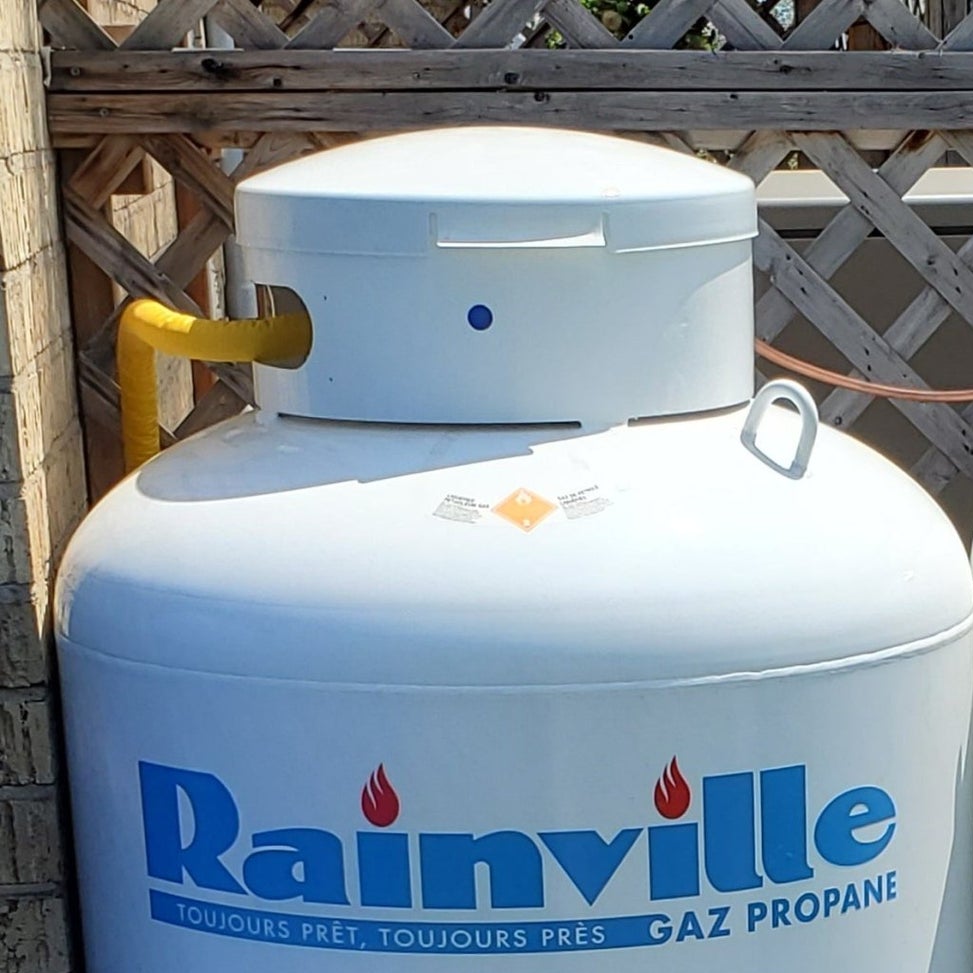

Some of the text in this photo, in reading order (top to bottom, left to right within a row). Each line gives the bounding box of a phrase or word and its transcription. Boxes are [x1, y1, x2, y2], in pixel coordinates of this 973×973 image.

[138, 755, 896, 910] Rainville
[176, 903, 606, 950] TOUJOURS PRÊT, TOUJOURS PRÈS
[649, 870, 897, 944] GAZ PROPANE
